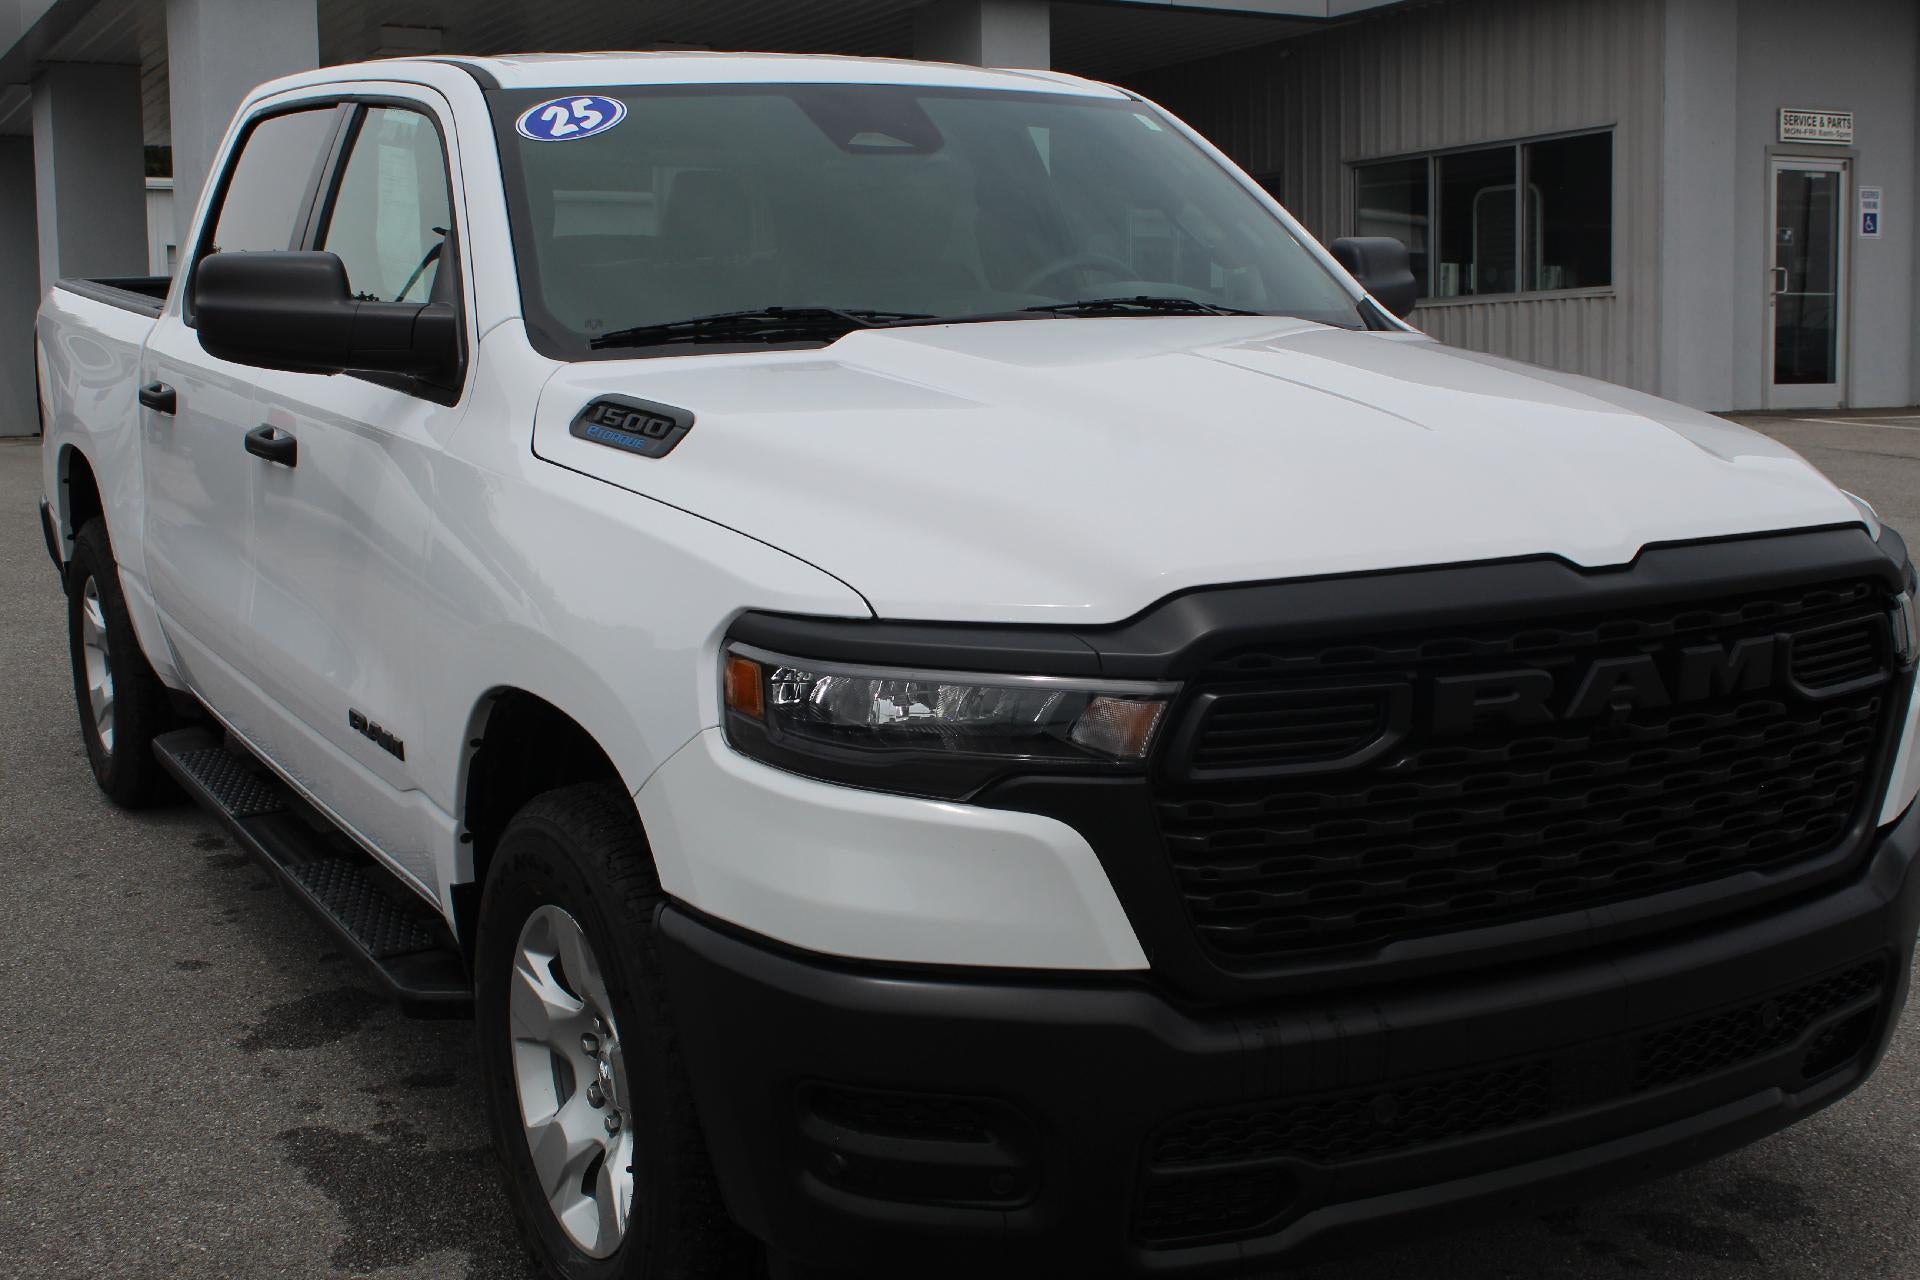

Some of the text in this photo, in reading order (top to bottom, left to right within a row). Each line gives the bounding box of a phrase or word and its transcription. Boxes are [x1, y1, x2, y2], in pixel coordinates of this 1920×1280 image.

[541, 98, 603, 137] 25
[1783, 114, 1851, 129] SERVICE & PARTS
[593, 405, 669, 437] 1500
[1432, 634, 1776, 736] RAM
[348, 707, 405, 762] RAM
